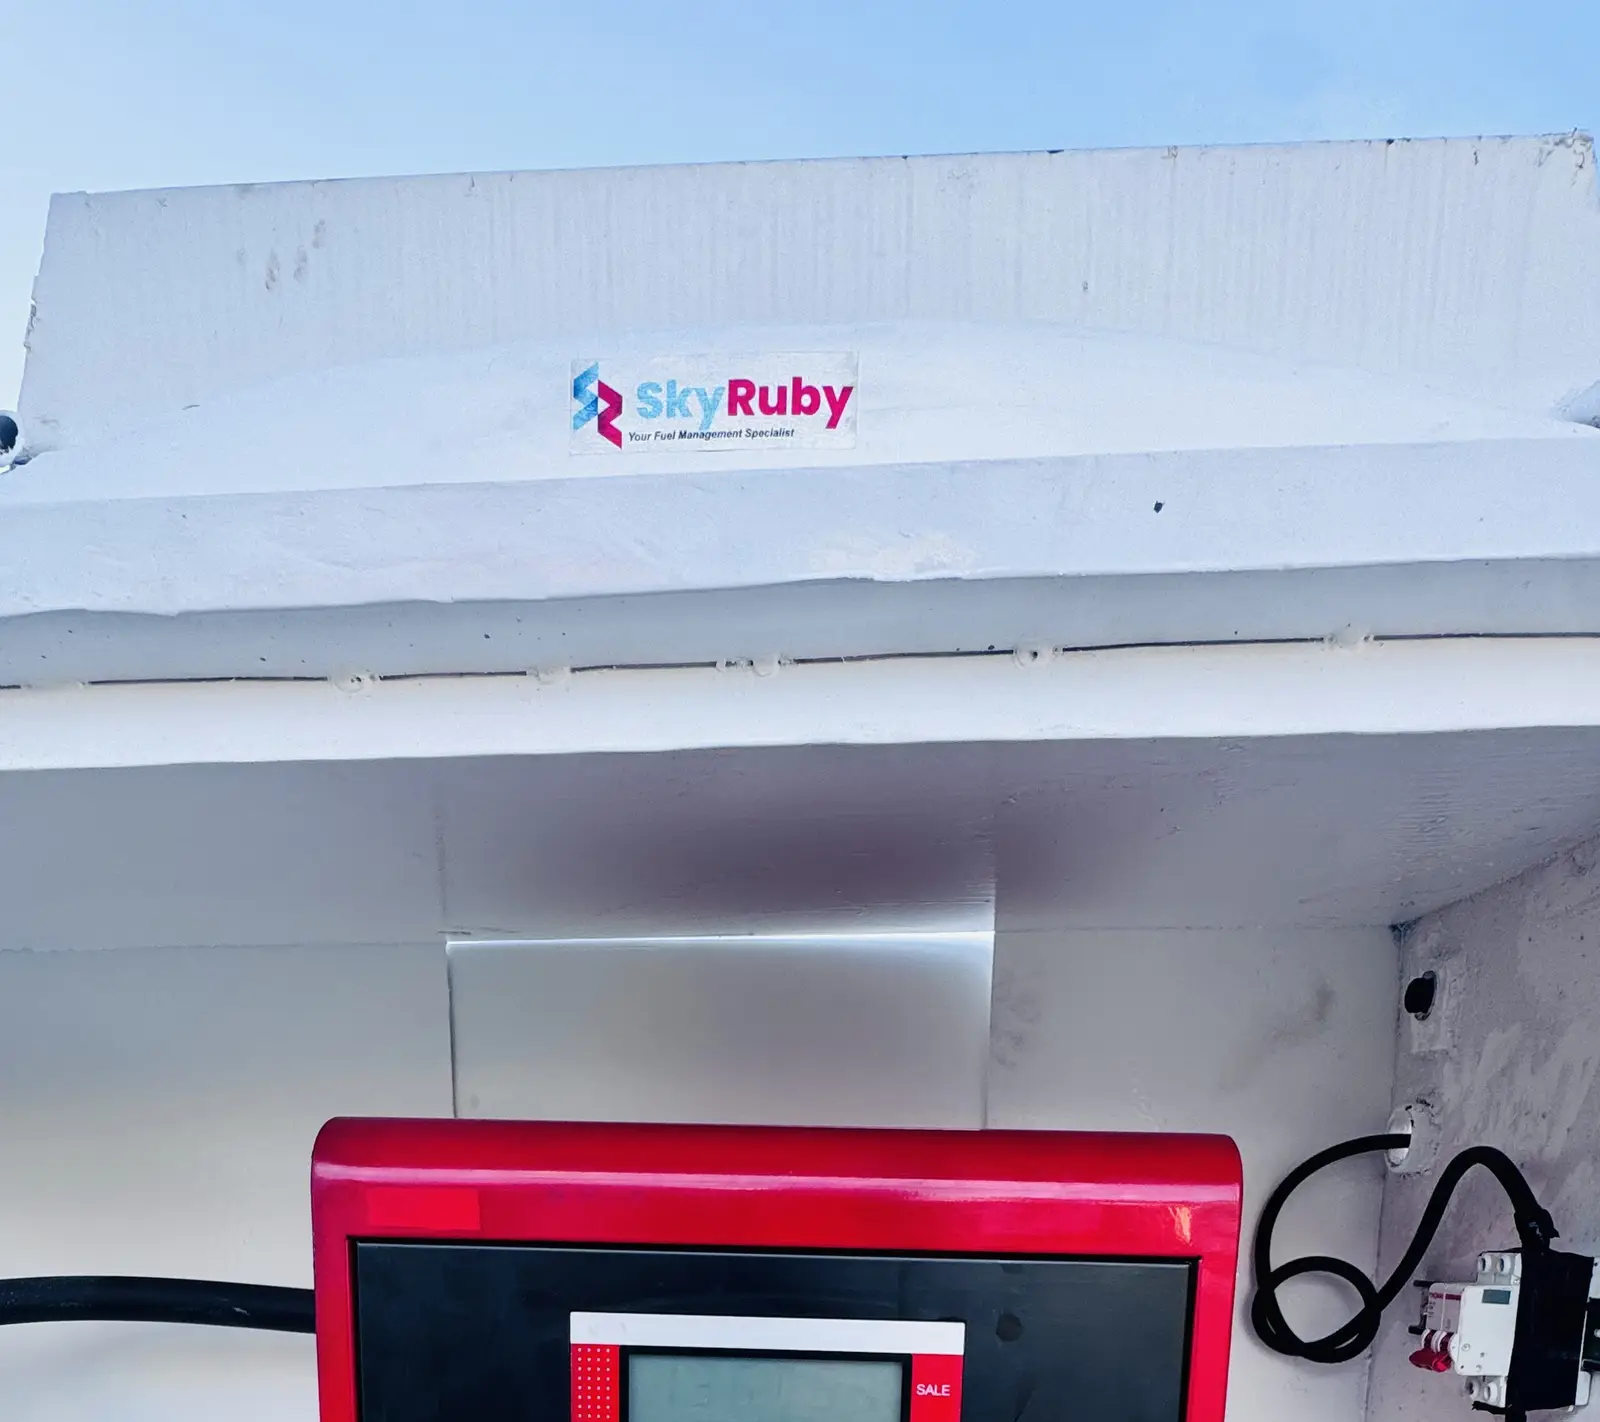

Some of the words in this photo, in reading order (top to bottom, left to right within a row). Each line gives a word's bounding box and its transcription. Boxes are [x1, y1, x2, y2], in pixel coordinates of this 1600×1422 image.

[637, 376, 854, 430] SkyRuby
[629, 431, 651, 442] Your
[654, 431, 676, 441] Fuel
[678, 429, 742, 442] Management
[745, 428, 795, 440] Specialist
[916, 1383, 951, 1397] SALE
